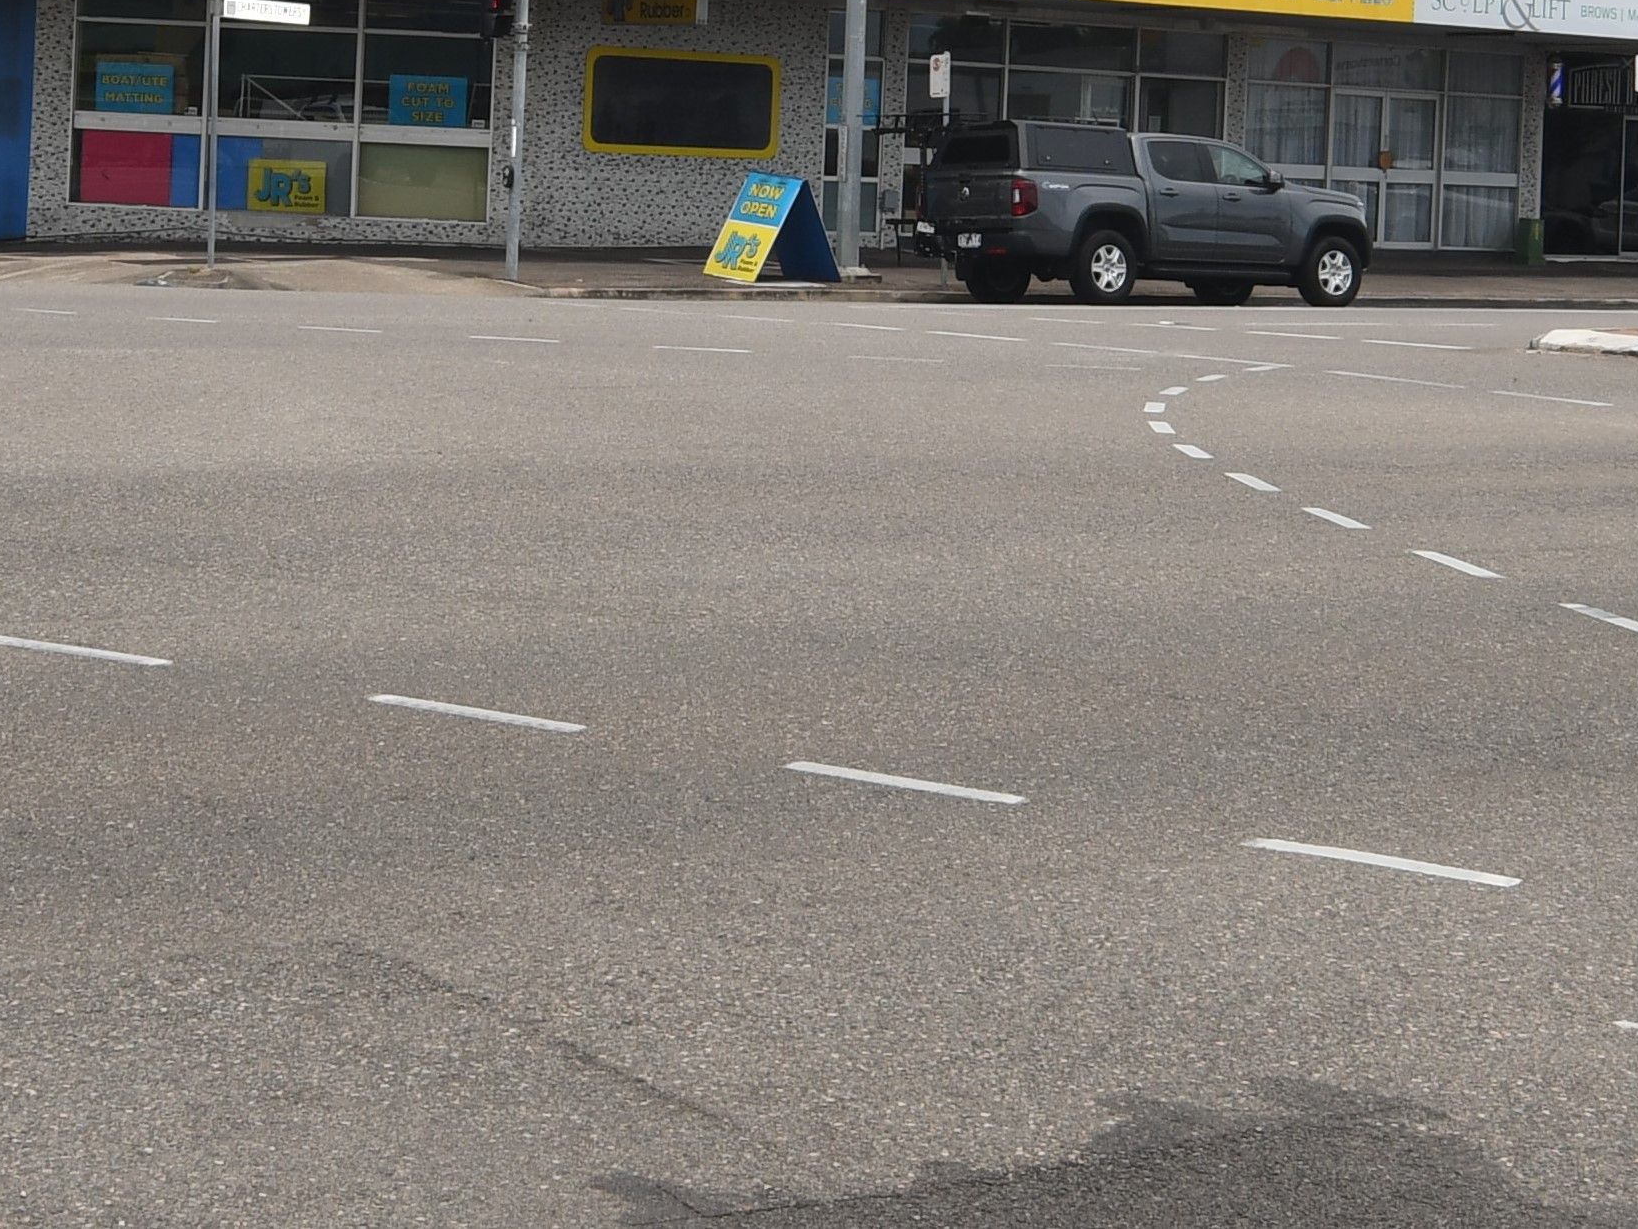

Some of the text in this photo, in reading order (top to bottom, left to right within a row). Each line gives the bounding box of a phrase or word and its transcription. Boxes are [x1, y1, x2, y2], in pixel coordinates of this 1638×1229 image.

[1580, 4, 1617, 20] BROWS
[749, 183, 785, 200] NOW
[741, 201, 778, 219] OPEN
